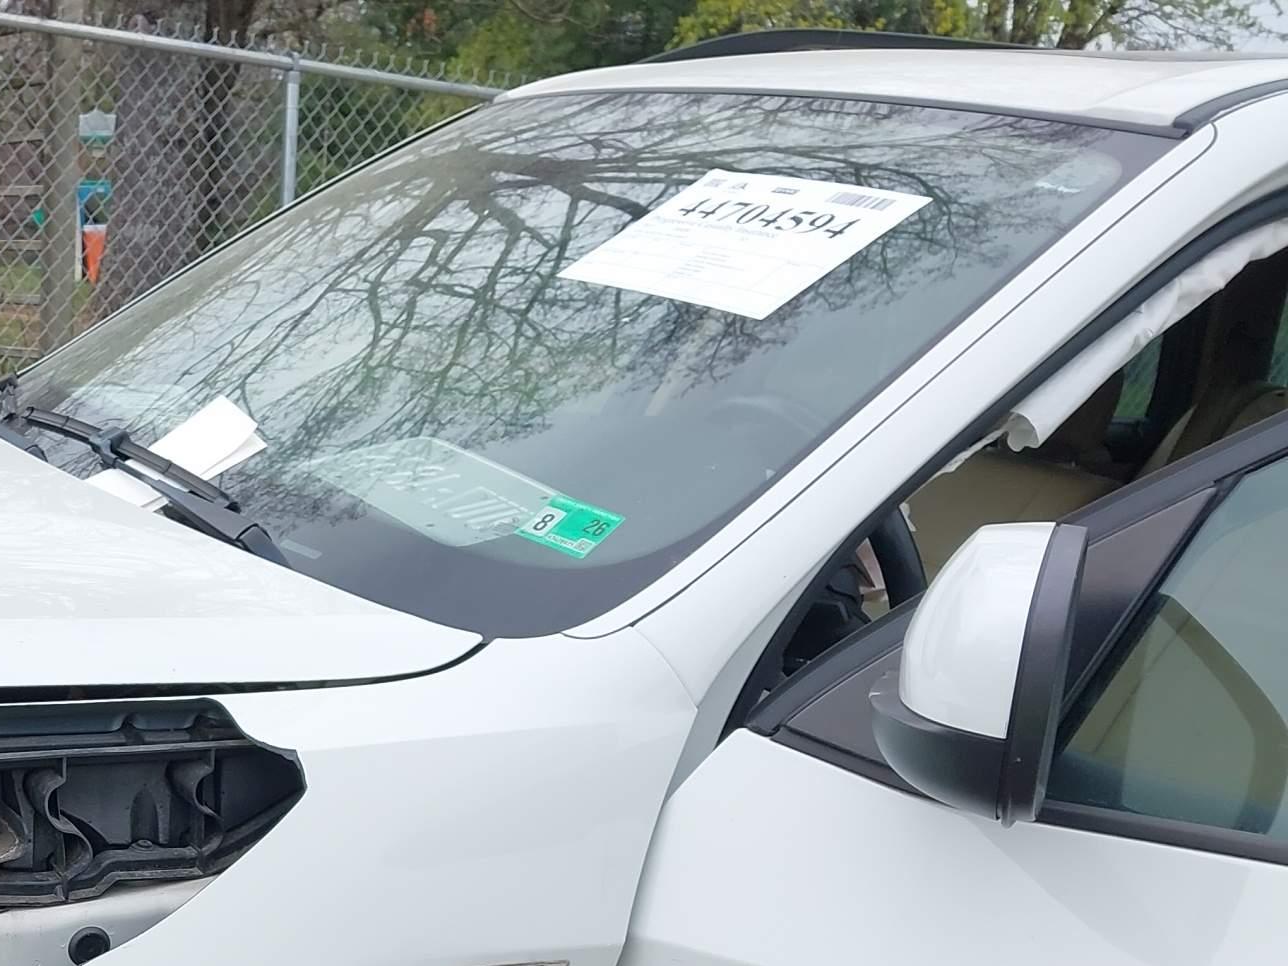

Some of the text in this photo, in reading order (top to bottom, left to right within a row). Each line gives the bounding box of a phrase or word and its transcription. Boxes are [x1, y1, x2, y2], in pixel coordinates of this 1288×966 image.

[677, 197, 861, 240] 44704594
[533, 513, 610, 537] 8 26
